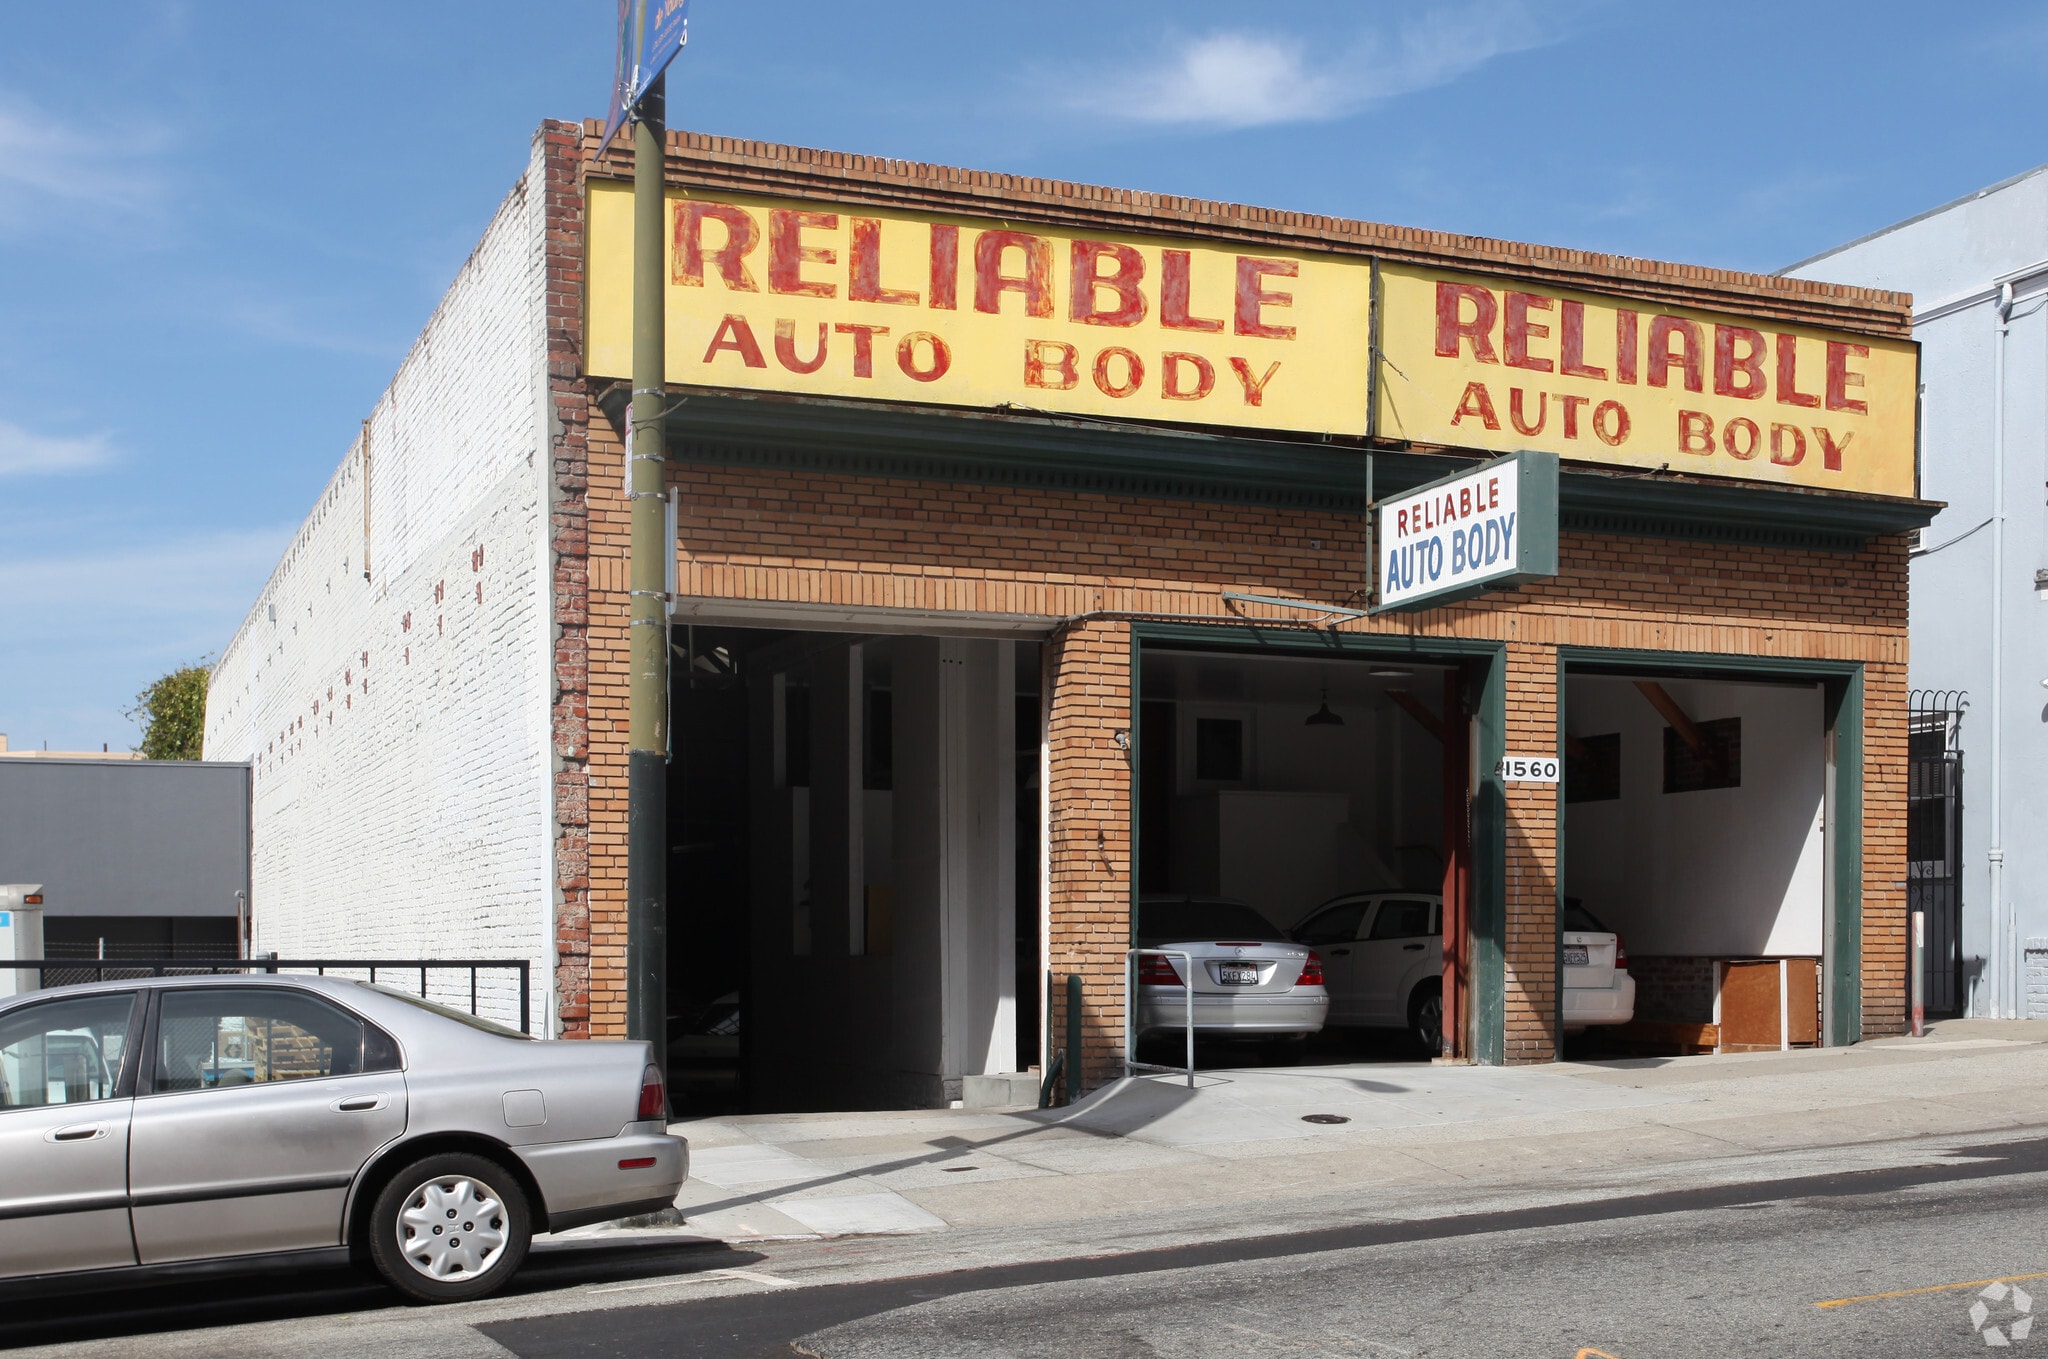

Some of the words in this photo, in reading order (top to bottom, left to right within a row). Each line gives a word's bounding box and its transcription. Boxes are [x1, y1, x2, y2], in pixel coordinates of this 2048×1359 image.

[672, 200, 1299, 340] RELIABLE
[703, 314, 952, 383] AUTO
[1024, 338, 1281, 407] BODY
[1435, 281, 1870, 416] RELIABLE
[1451, 381, 1632, 447] AUTO
[1678, 409, 1855, 472] BODY
[1386, 535, 1443, 594] AUTO
[1452, 511, 1516, 576] BODY
[1398, 476, 1499, 538] RELIABLE
[1506, 761, 1556, 777] 1560
